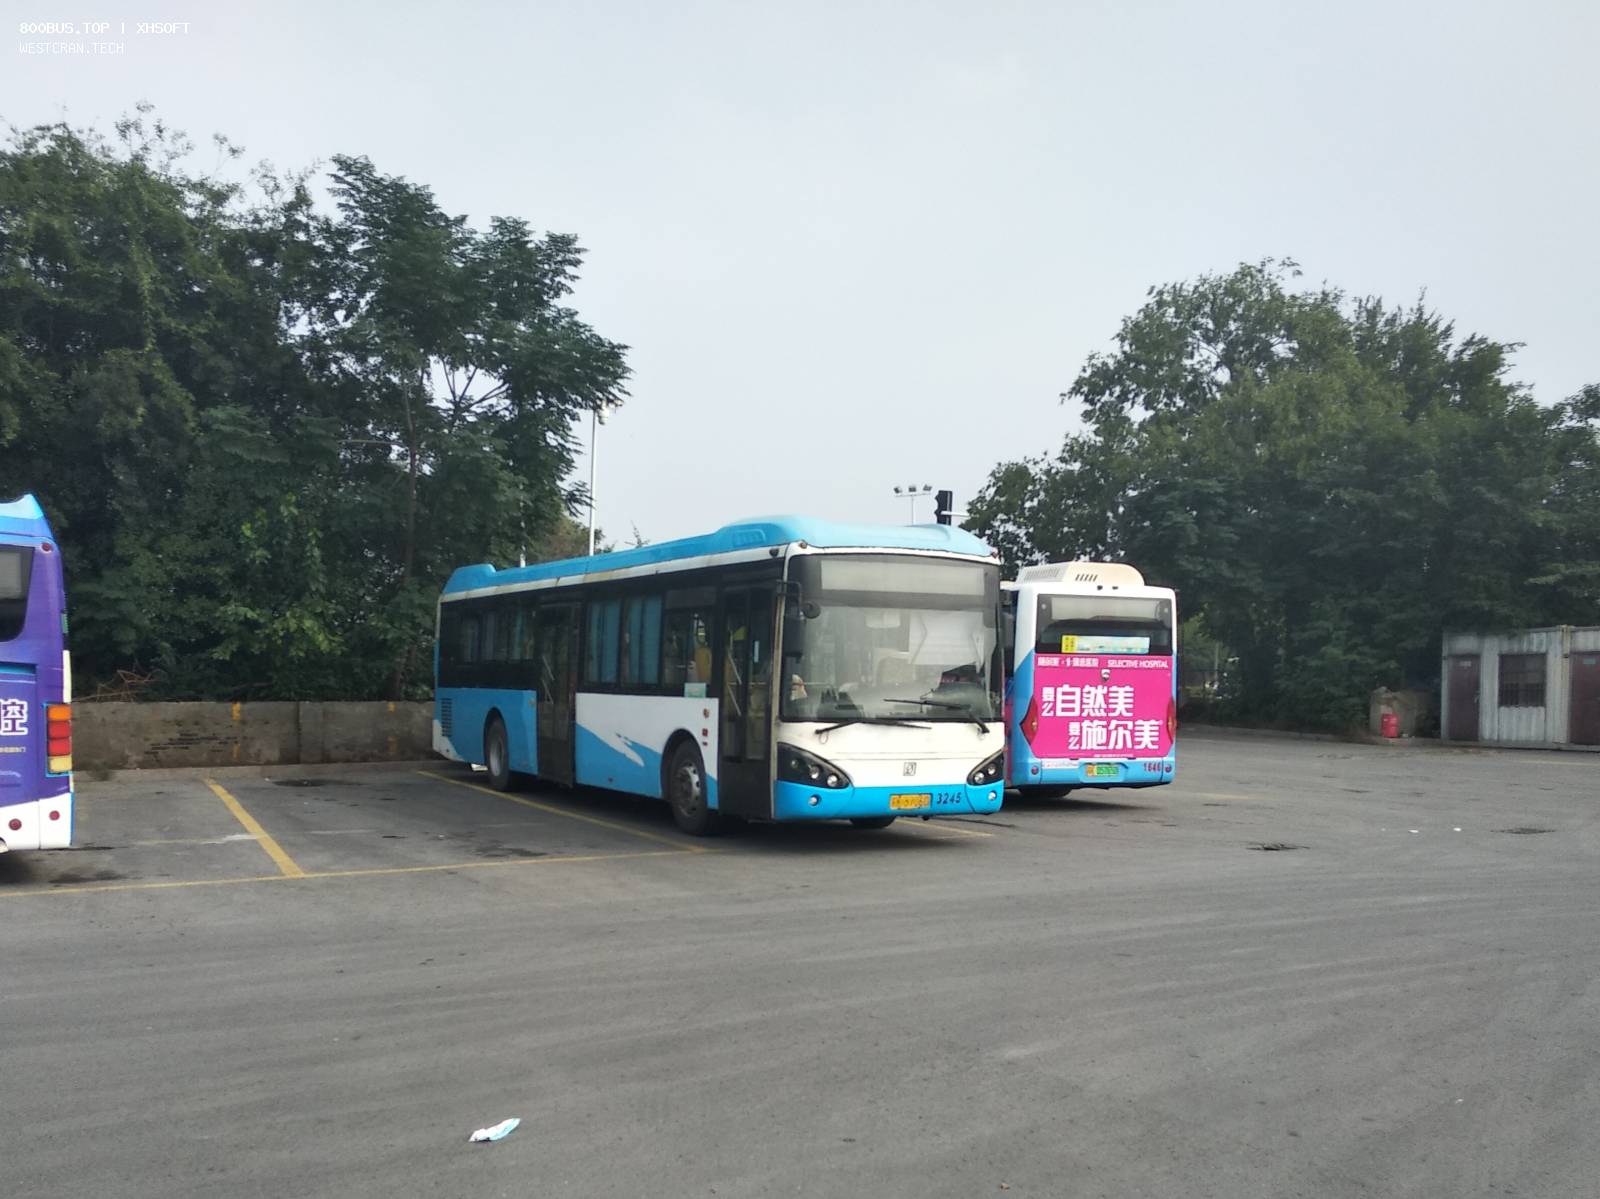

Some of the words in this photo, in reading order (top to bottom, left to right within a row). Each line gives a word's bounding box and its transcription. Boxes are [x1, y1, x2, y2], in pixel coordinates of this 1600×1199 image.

[1055, 684, 1134, 717] 自然美
[1081, 719, 1159, 750] 施尔美
[936, 791, 961, 805] 3245
